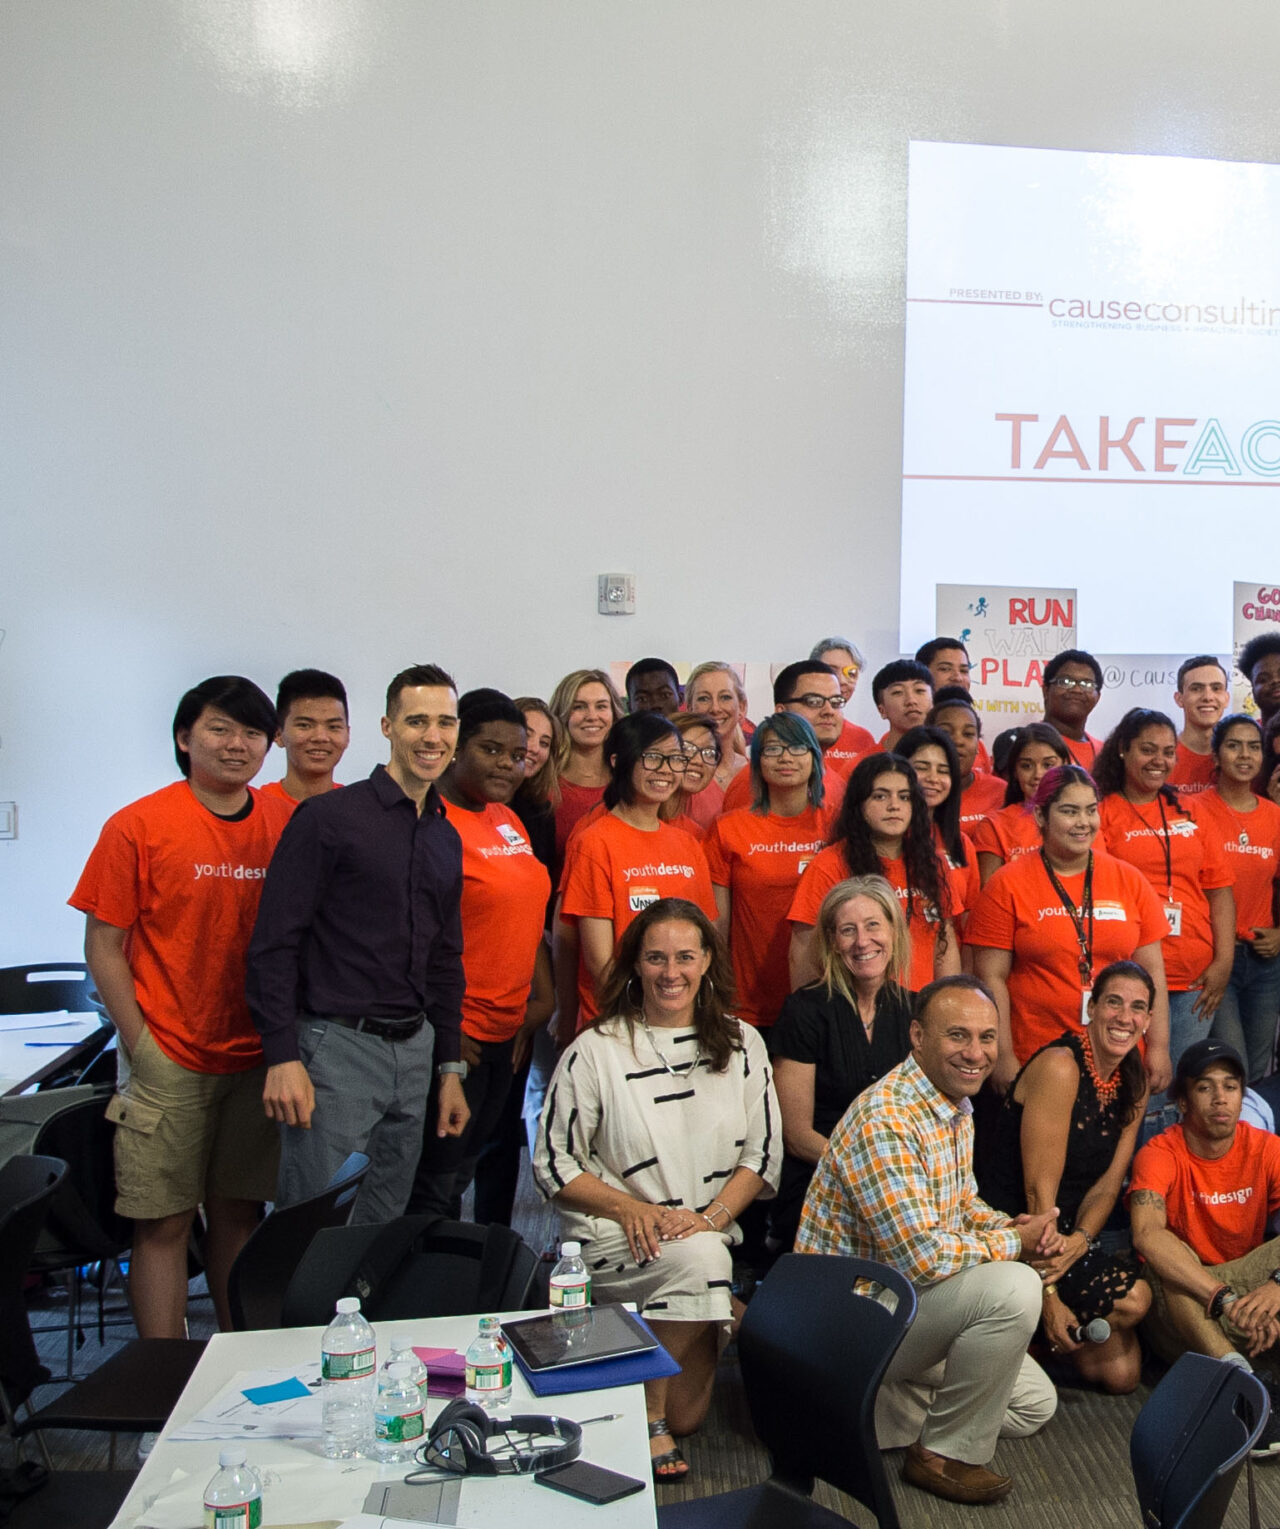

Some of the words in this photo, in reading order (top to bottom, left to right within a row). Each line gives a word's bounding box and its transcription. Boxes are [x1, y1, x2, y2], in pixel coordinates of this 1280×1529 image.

[949, 288, 1022, 300] PRESENTED
[1025, 291, 1043, 301] BY:
[1051, 320, 1132, 330] STRENGTHENING
[1008, 598, 1073, 627] RUN
[984, 628, 1075, 656] WALK
[986, 700, 1020, 713] WITH
[748, 840, 826, 855] youthdesig
[194, 863, 267, 880] youthdesi
[623, 862, 695, 882] youthdesign
